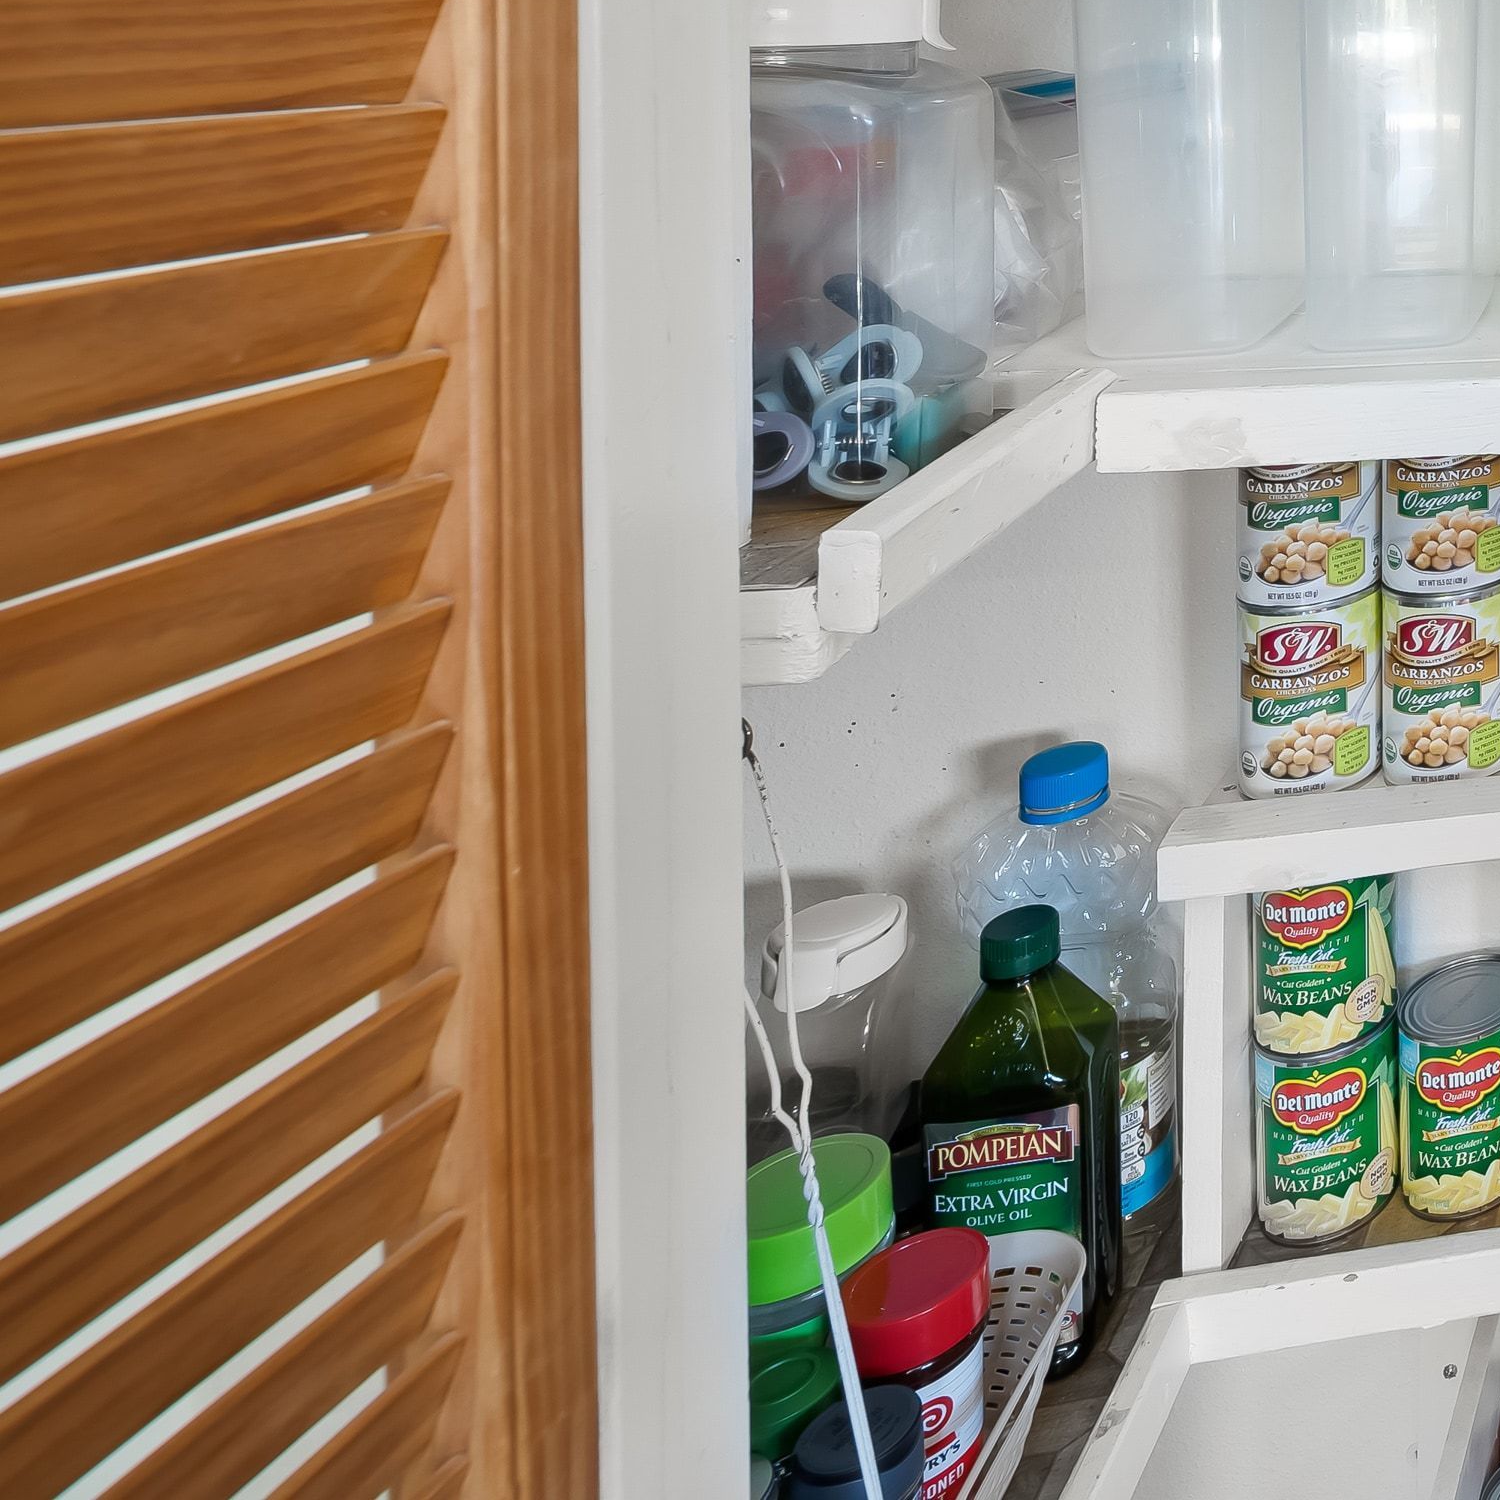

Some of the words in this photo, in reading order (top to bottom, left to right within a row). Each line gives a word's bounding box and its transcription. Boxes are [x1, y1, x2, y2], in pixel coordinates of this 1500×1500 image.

[1246, 475, 1343, 495] GARBANZOS
[1252, 502, 1333, 528] Organic
[1264, 625, 1331, 664] S&W
[1252, 667, 1349, 689] GARBANZOS
[1257, 694, 1341, 724] Organic
[1265, 903, 1287, 923] Del
[1290, 899, 1345, 924] Monte
[1284, 926, 1319, 938] Quality
[1263, 985, 1293, 1006] WAX
[1296, 981, 1352, 1006] BEANS
[1282, 980, 1293, 989] Cut
[1296, 978, 1325, 989] Golden
[938, 1131, 1062, 1171] POMPEIAN
[936, 1195, 994, 1212] EXTRA
[998, 1177, 1069, 1206] VIRGIN
[967, 1213, 1005, 1226] OLIVE
[1009, 1209, 1032, 1220] OIL
